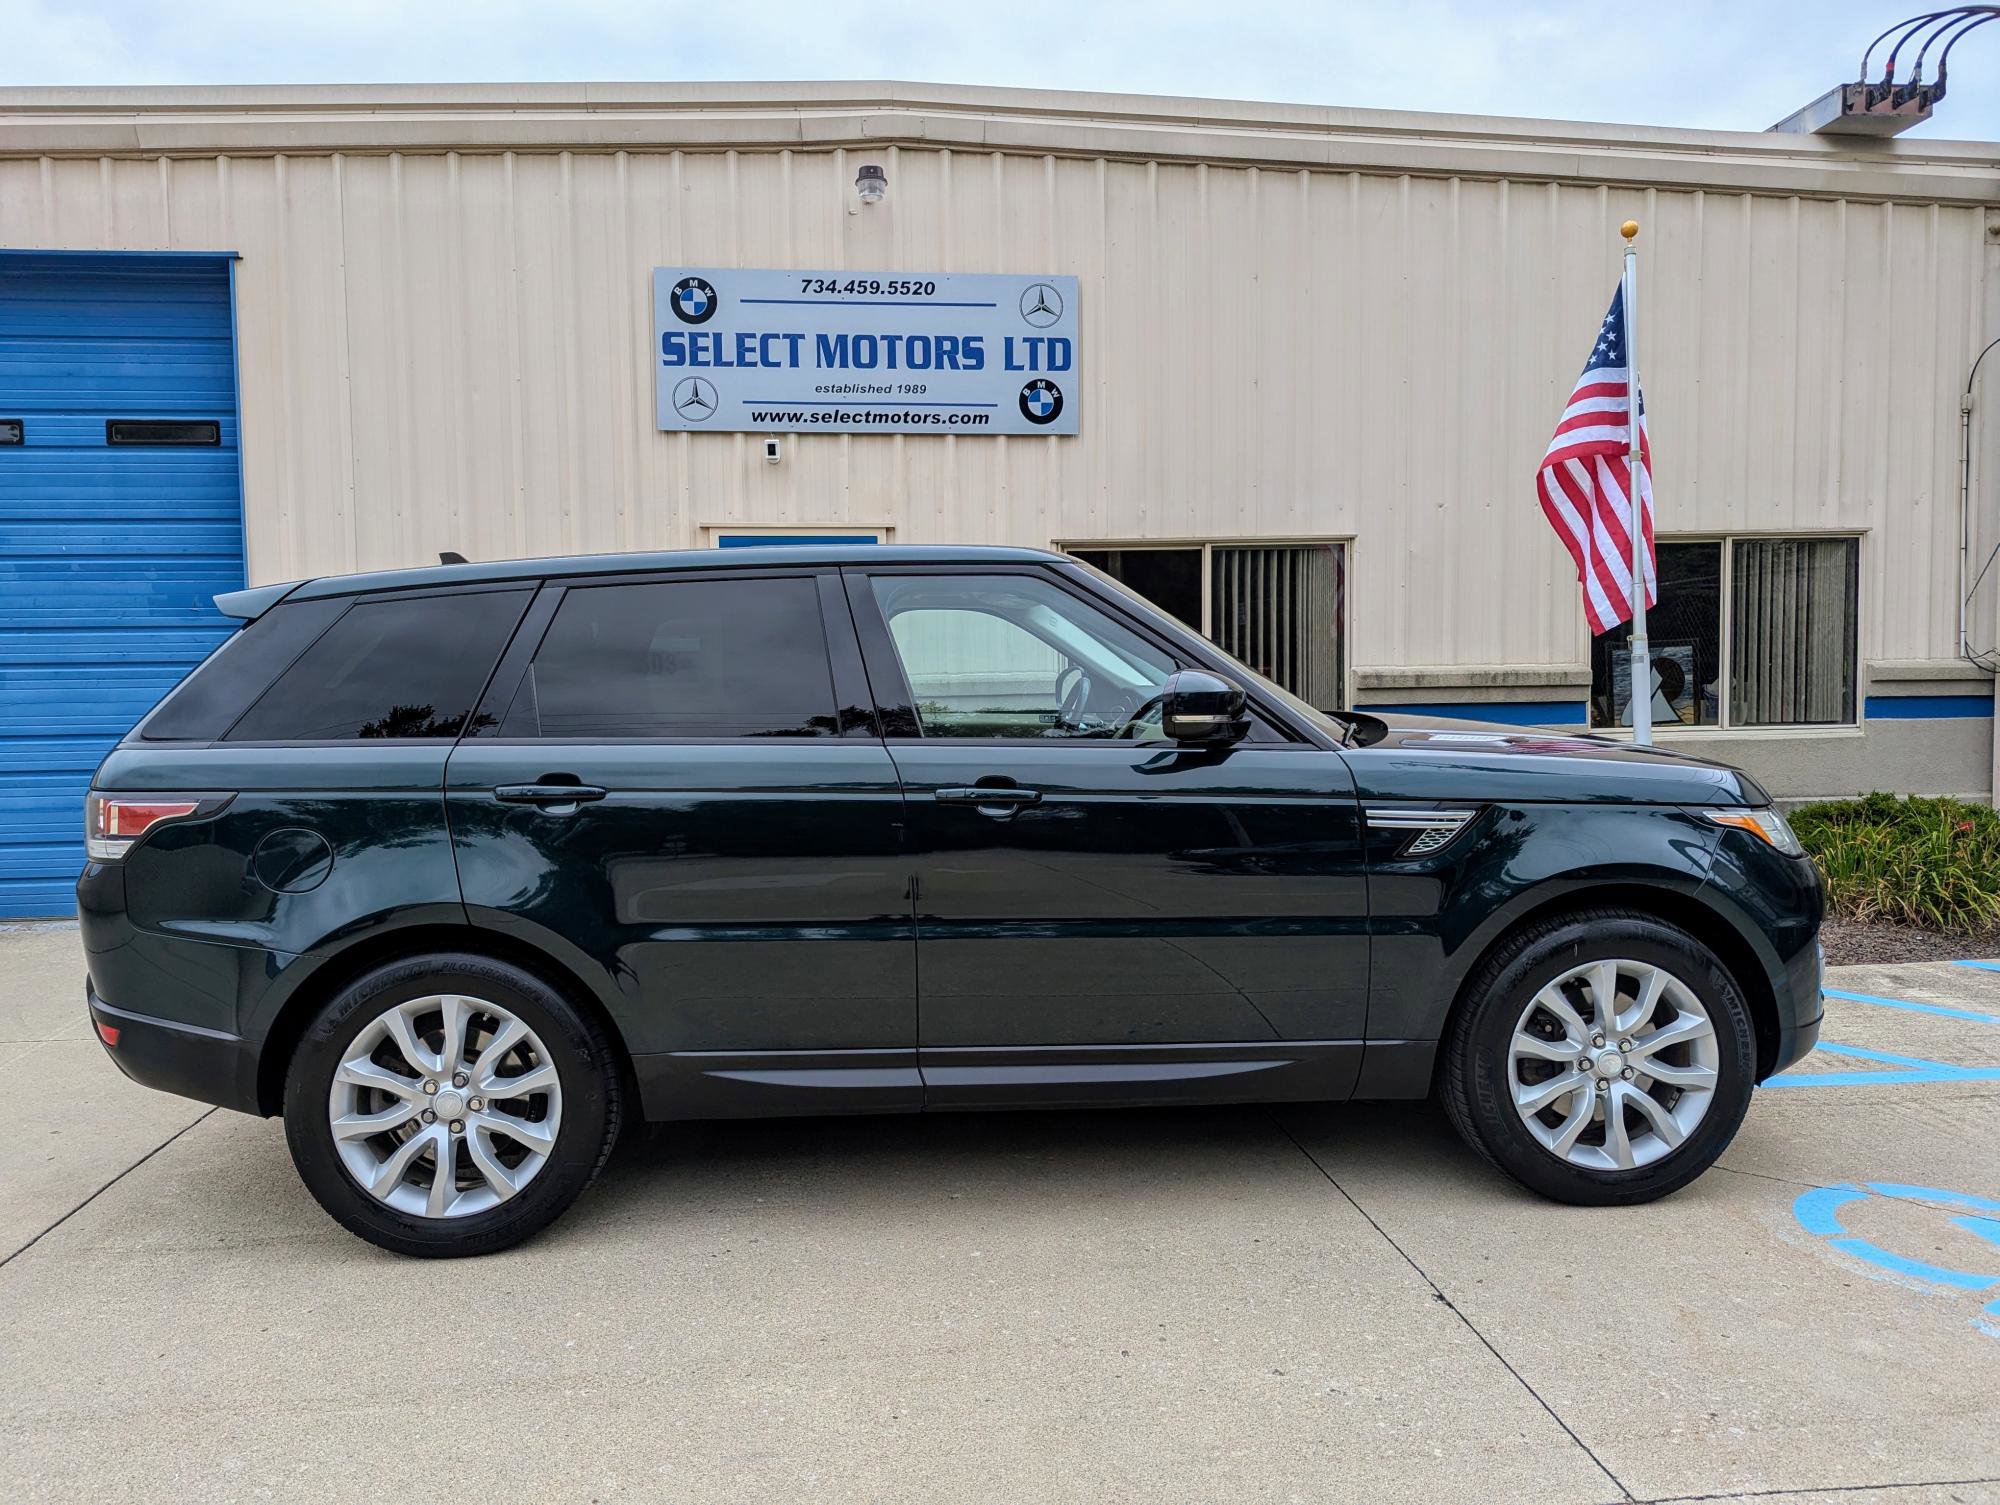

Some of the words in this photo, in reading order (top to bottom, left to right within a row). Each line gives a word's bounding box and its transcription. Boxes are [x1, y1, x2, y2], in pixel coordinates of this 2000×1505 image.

[674, 280, 714, 297] BMW
[801, 279, 936, 296] 734.459.5520
[661, 331, 806, 369] SELECT
[815, 333, 985, 371] MOTORS
[1003, 336, 1072, 372] LTD
[815, 383, 893, 395] established
[896, 384, 927, 395] 1989
[1023, 381, 1060, 398] BMW
[751, 409, 990, 429] www.selectmotors.com
